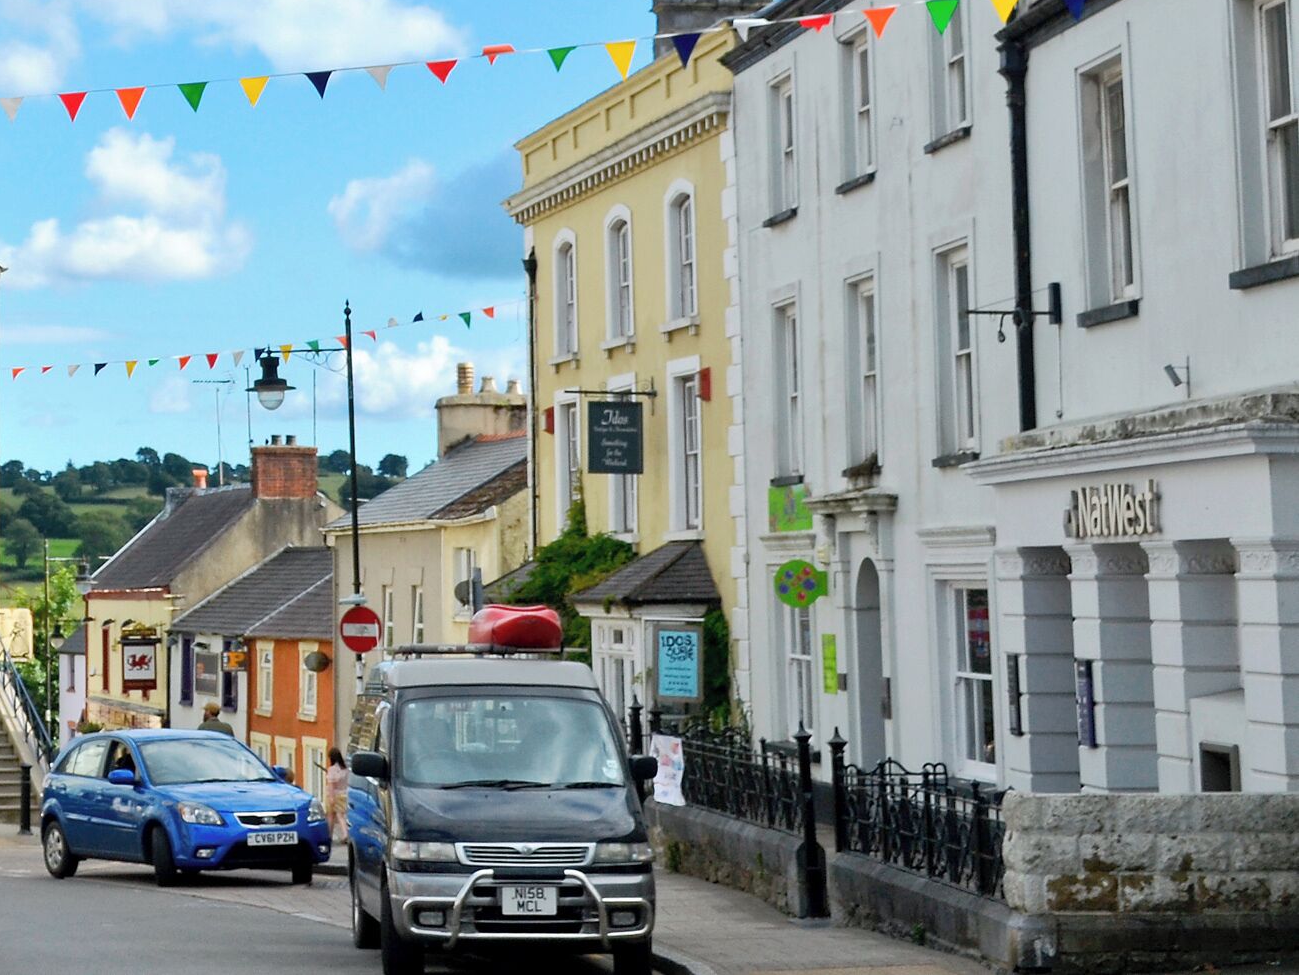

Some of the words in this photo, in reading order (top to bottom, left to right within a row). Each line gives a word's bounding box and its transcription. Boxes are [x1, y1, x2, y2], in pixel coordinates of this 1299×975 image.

[1078, 481, 1154, 538] NatWest
[254, 833, 275, 844] CV61
[277, 832, 295, 843] PZH
[517, 900, 542, 912] MCL
